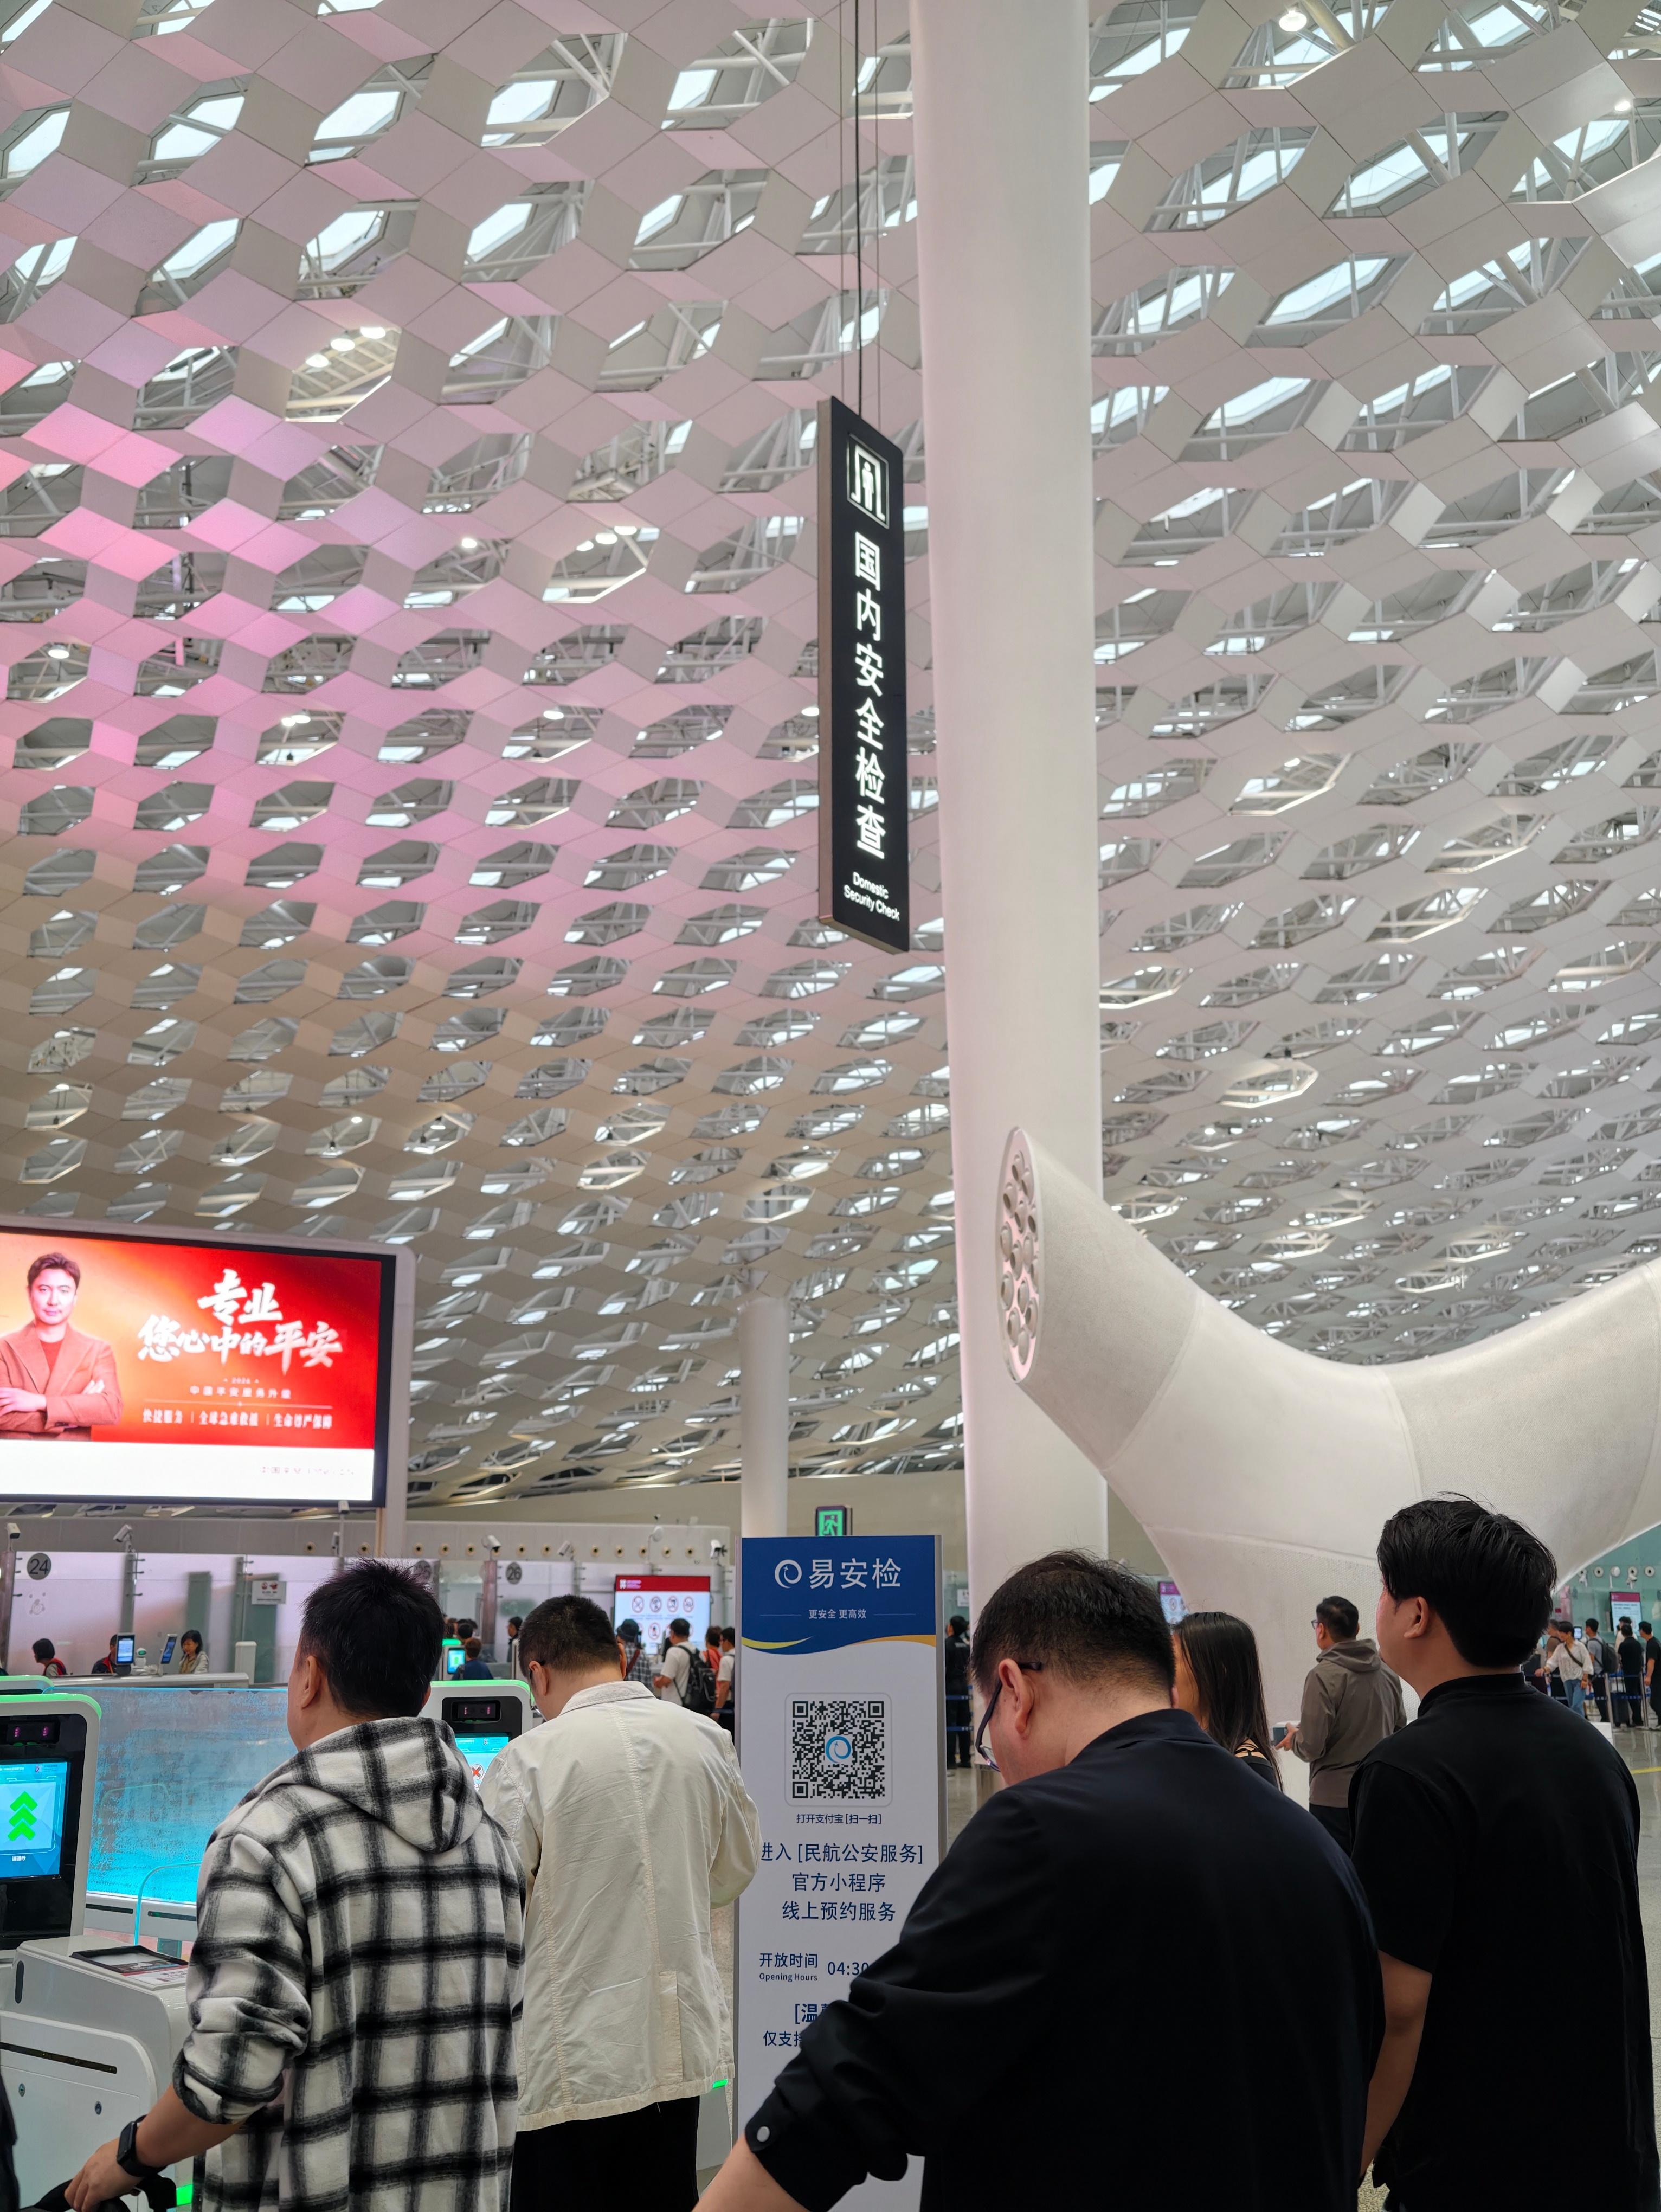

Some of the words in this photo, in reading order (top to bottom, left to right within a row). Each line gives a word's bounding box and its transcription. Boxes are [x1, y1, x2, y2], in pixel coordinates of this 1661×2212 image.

[855, 531, 886, 859] 国内安全检查
[853, 871, 889, 899] Domestic
[844, 884, 875, 912] Security
[875, 899, 900, 921] Check
[197, 1269, 283, 1326] 专业
[138, 1314, 343, 1375] 您心中的平安
[29, 1558, 49, 1575] 24
[506, 1566, 521, 1580] 26
[809, 1558, 901, 1589] 易安检
[809, 1609, 836, 1619] 更安全
[839, 1609, 867, 1619] 更高效
[761, 1842, 792, 1861] 进入
[798, 1843, 923, 1864] [民航公安服务]
[792, 1872, 885, 1893] 官方小程序
[782, 1900, 896, 1922] 线上预约服务
[759, 1952, 817, 1969] 开放时间
[759, 1972, 793, 1983] Opening
[794, 1973, 817, 1981] Hours
[795, 2003, 828, 2024] [温
